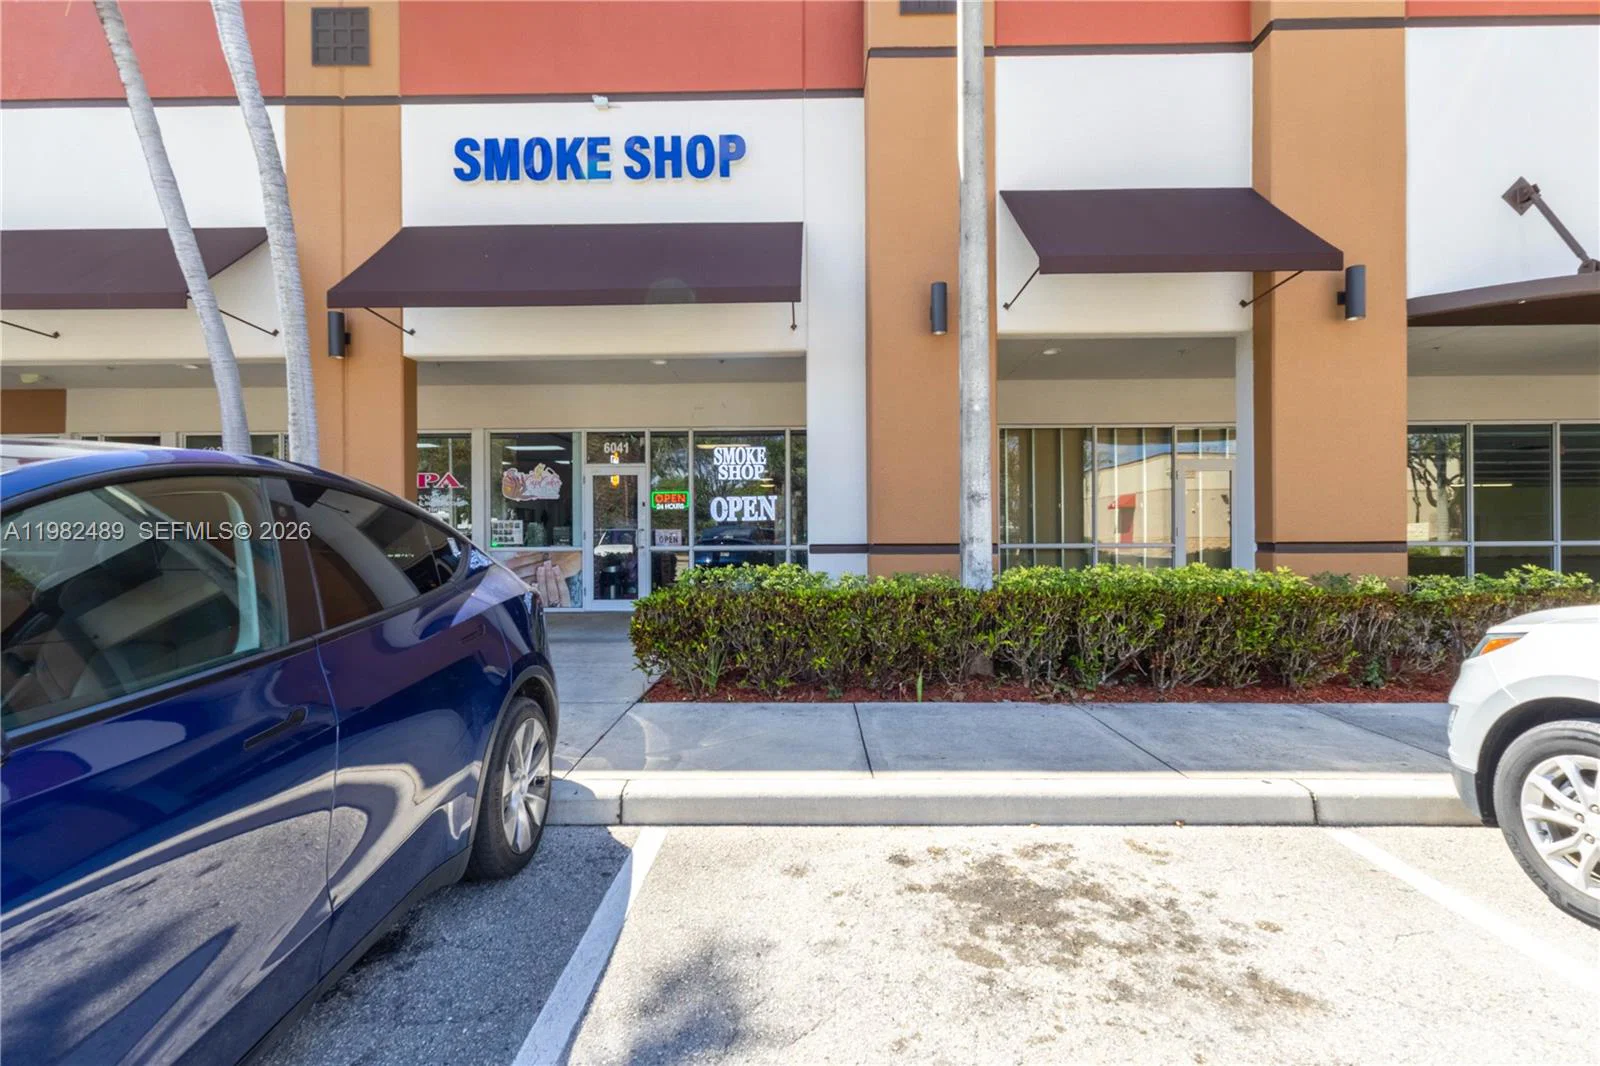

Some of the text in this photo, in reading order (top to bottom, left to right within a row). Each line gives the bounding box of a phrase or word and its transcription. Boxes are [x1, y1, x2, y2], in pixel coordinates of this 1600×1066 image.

[453, 134, 747, 182] SMOKE SHOP
[604, 442, 629, 453] 6041
[713, 447, 767, 465] SMOKE
[718, 464, 764, 480] SHOP
[655, 494, 686, 503] OPEN
[710, 495, 777, 521] OPEN
[658, 535, 679, 543] OPEN
